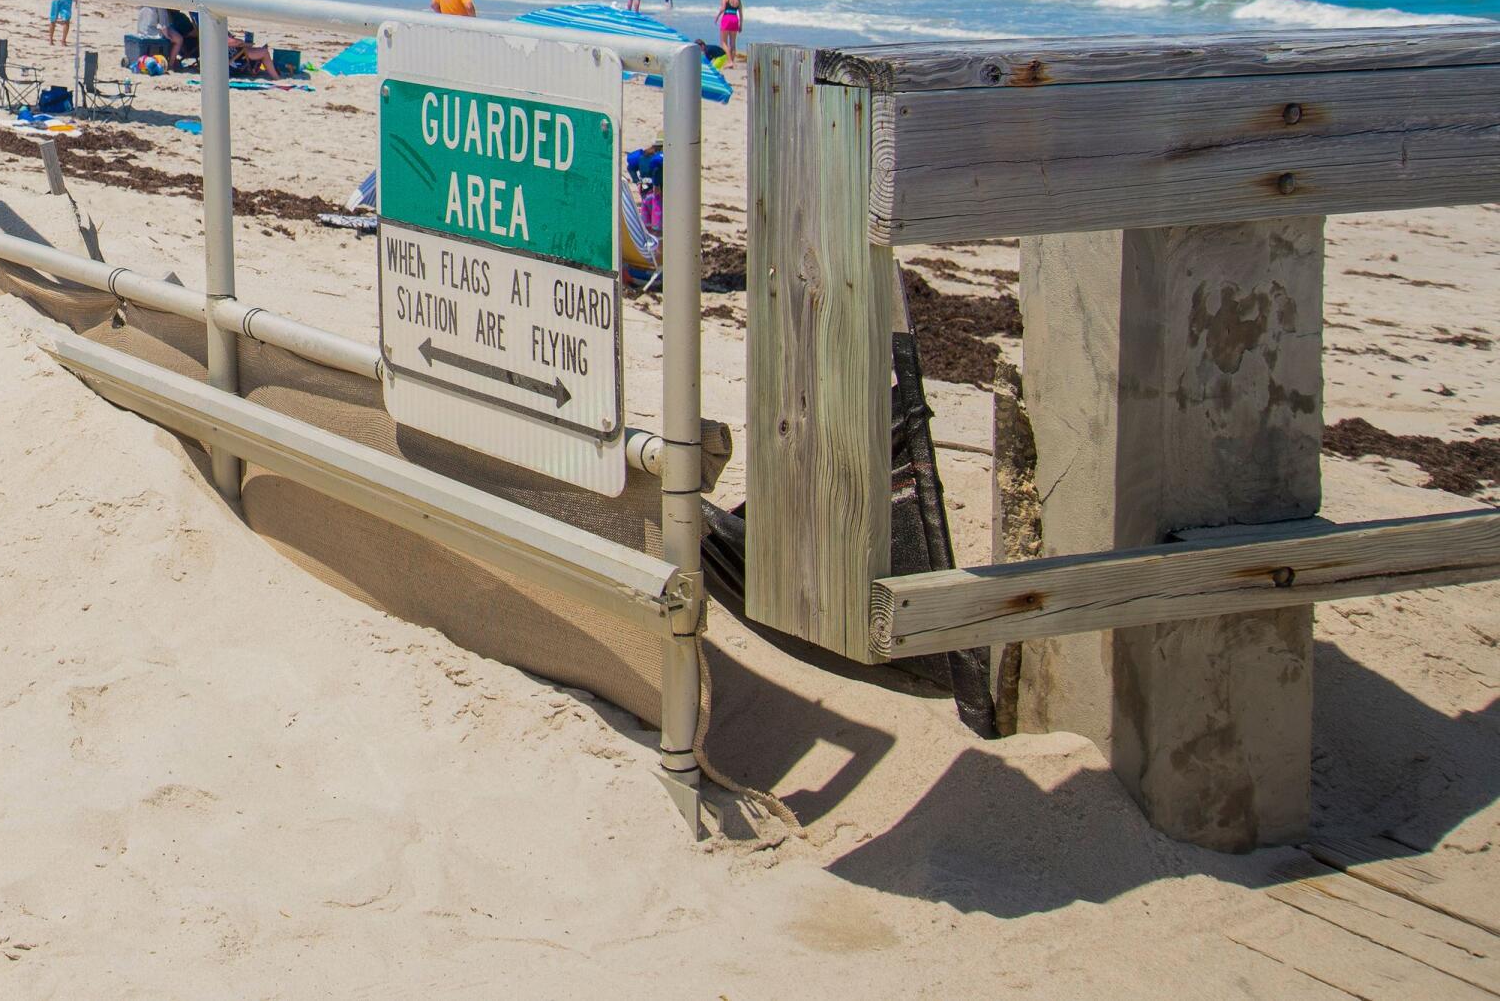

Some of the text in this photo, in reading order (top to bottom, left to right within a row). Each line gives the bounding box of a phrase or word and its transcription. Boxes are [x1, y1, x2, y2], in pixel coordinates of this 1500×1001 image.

[421, 91, 575, 172] GUARDED
[444, 171, 530, 242] AREA
[386, 236, 612, 331] WHEN FLAGS AT GUARD
[396, 285, 588, 377] STATION ARE FLYING
